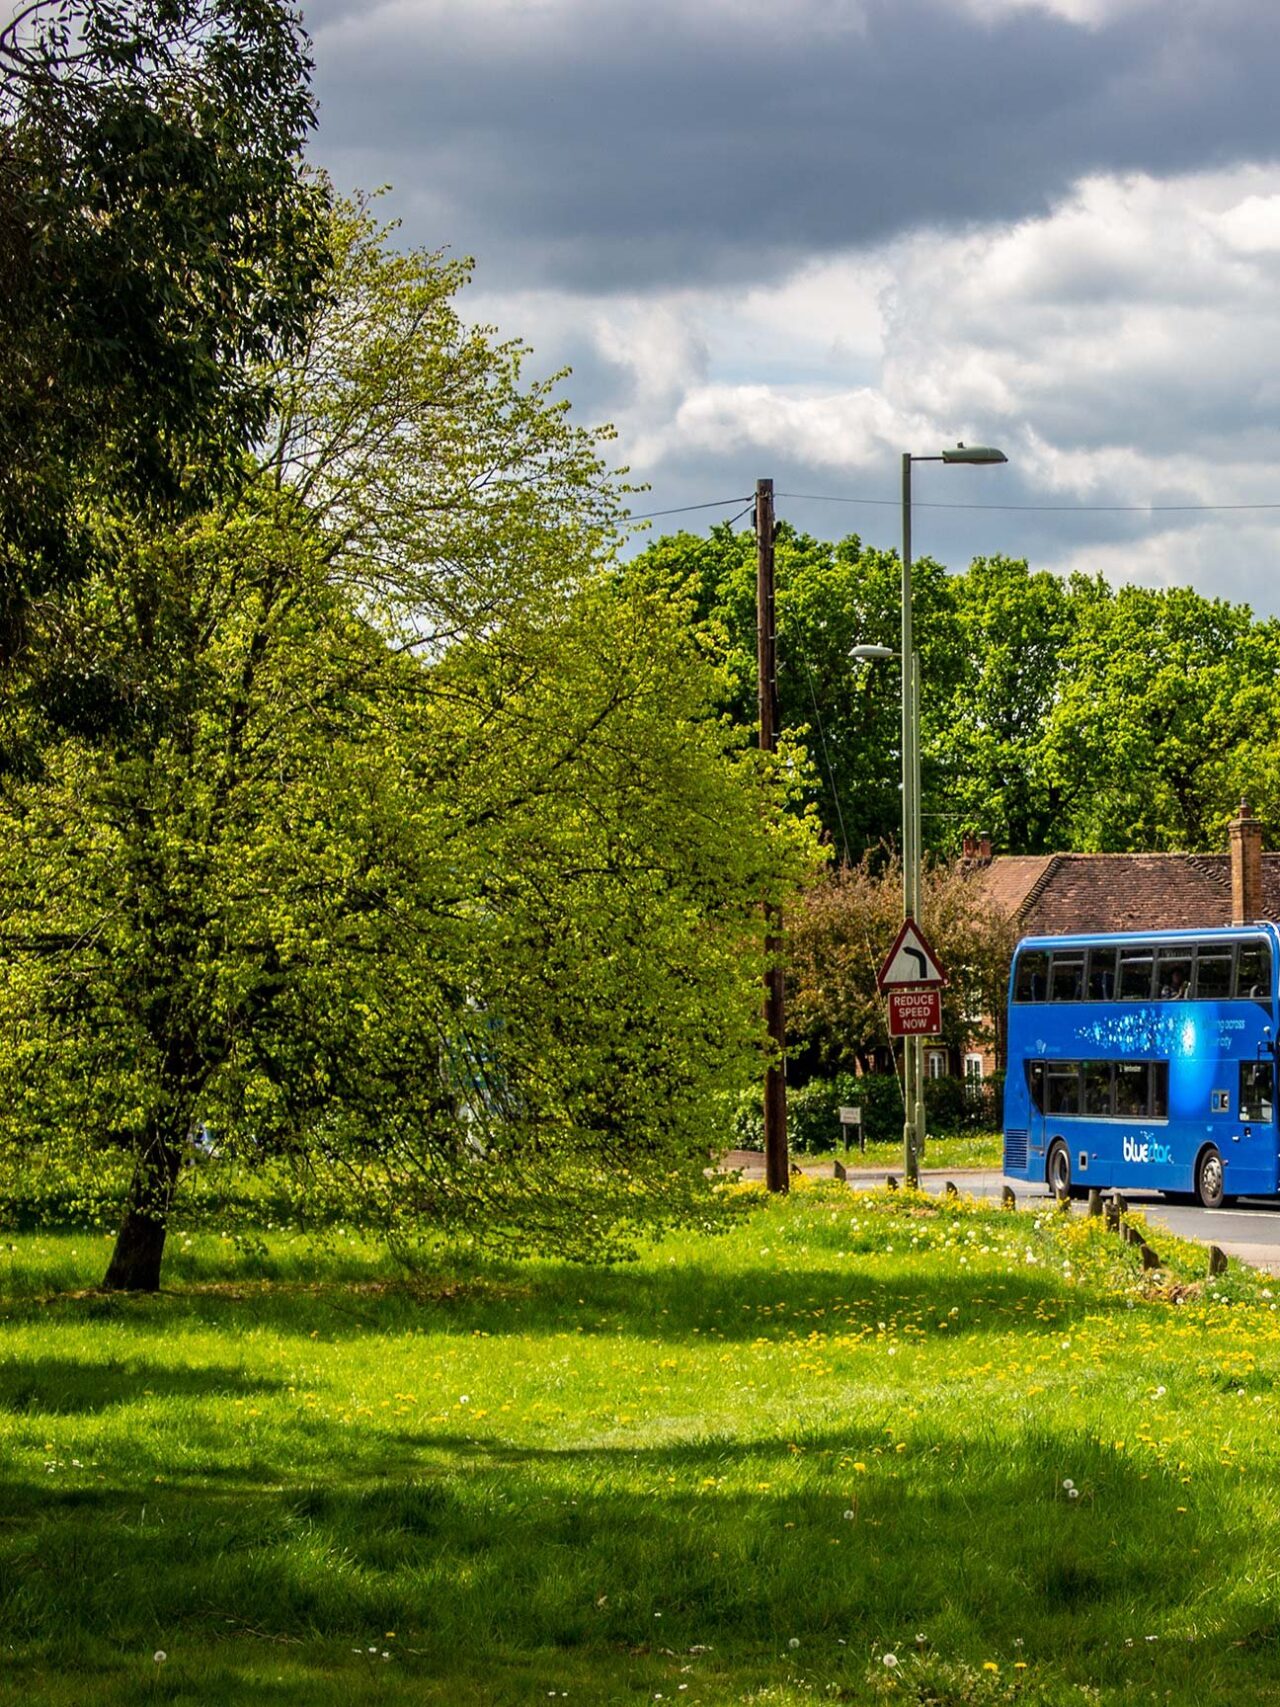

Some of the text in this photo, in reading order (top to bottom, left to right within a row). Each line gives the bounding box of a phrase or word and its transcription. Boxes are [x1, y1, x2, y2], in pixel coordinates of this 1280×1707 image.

[894, 994, 934, 1006] REDUCE
[898, 1006, 931, 1018] SPEED
[902, 1018, 928, 1029] NOW
